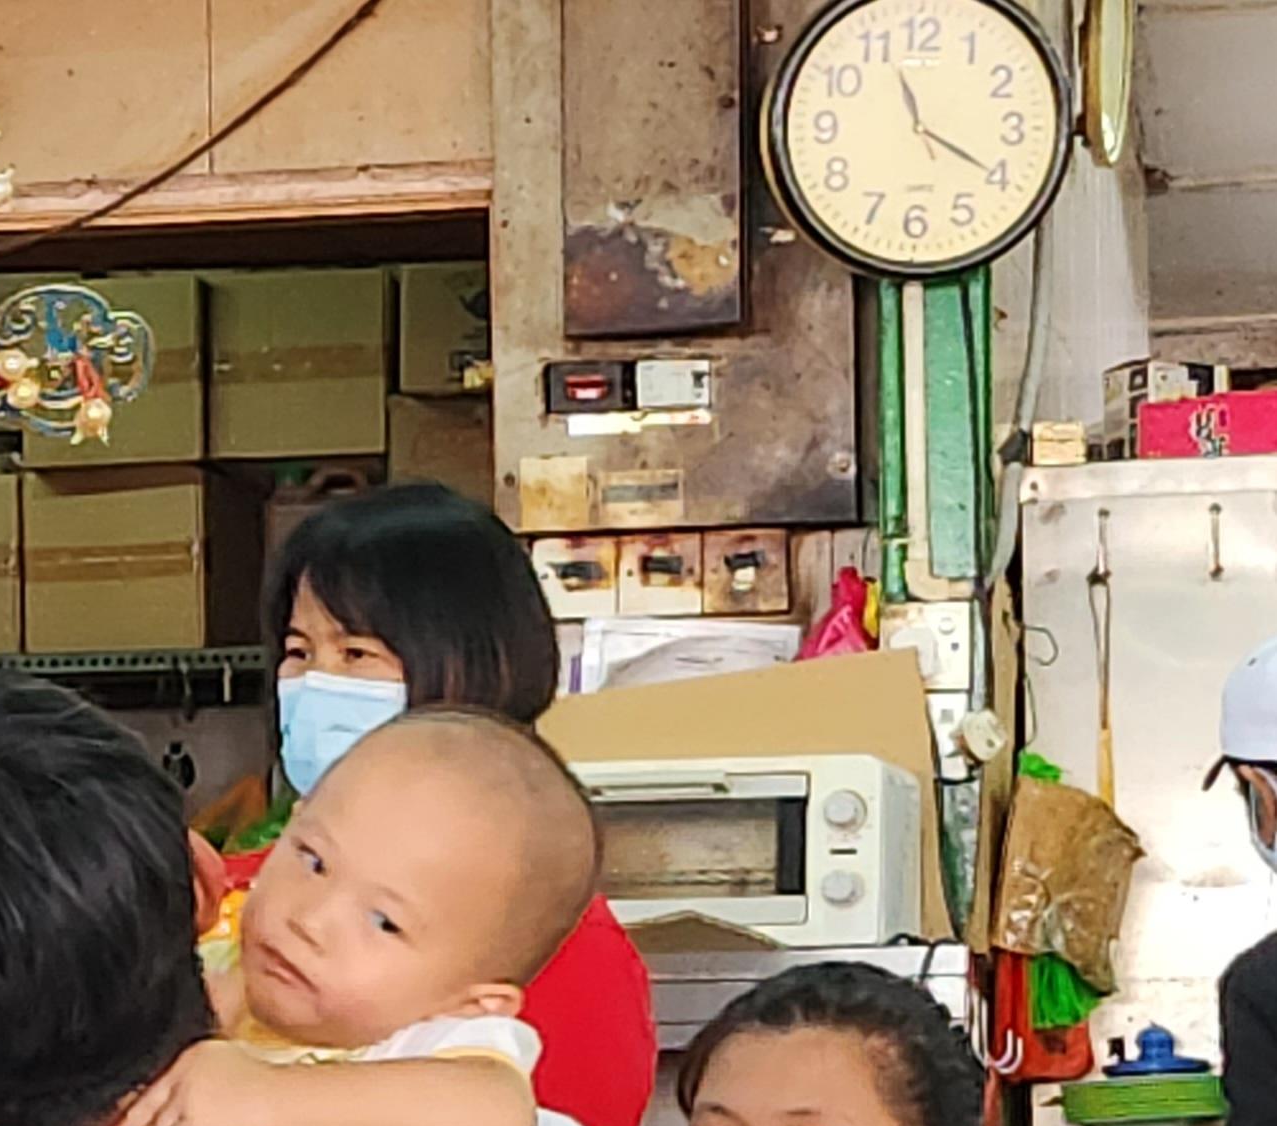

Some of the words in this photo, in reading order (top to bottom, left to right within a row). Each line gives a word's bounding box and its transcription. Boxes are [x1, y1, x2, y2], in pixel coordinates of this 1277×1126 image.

[859, 31, 891, 63] 11
[900, 17, 941, 52] 12
[961, 31, 976, 65] 1
[824, 64, 862, 98] 10
[990, 65, 1014, 98] 2
[813, 110, 838, 144] 9
[1000, 111, 1025, 146] 3
[824, 157, 849, 192] 8
[985, 160, 1010, 191] 4
[863, 192, 886, 225] 7
[903, 205, 929, 239] 6
[950, 193, 974, 227] 5
